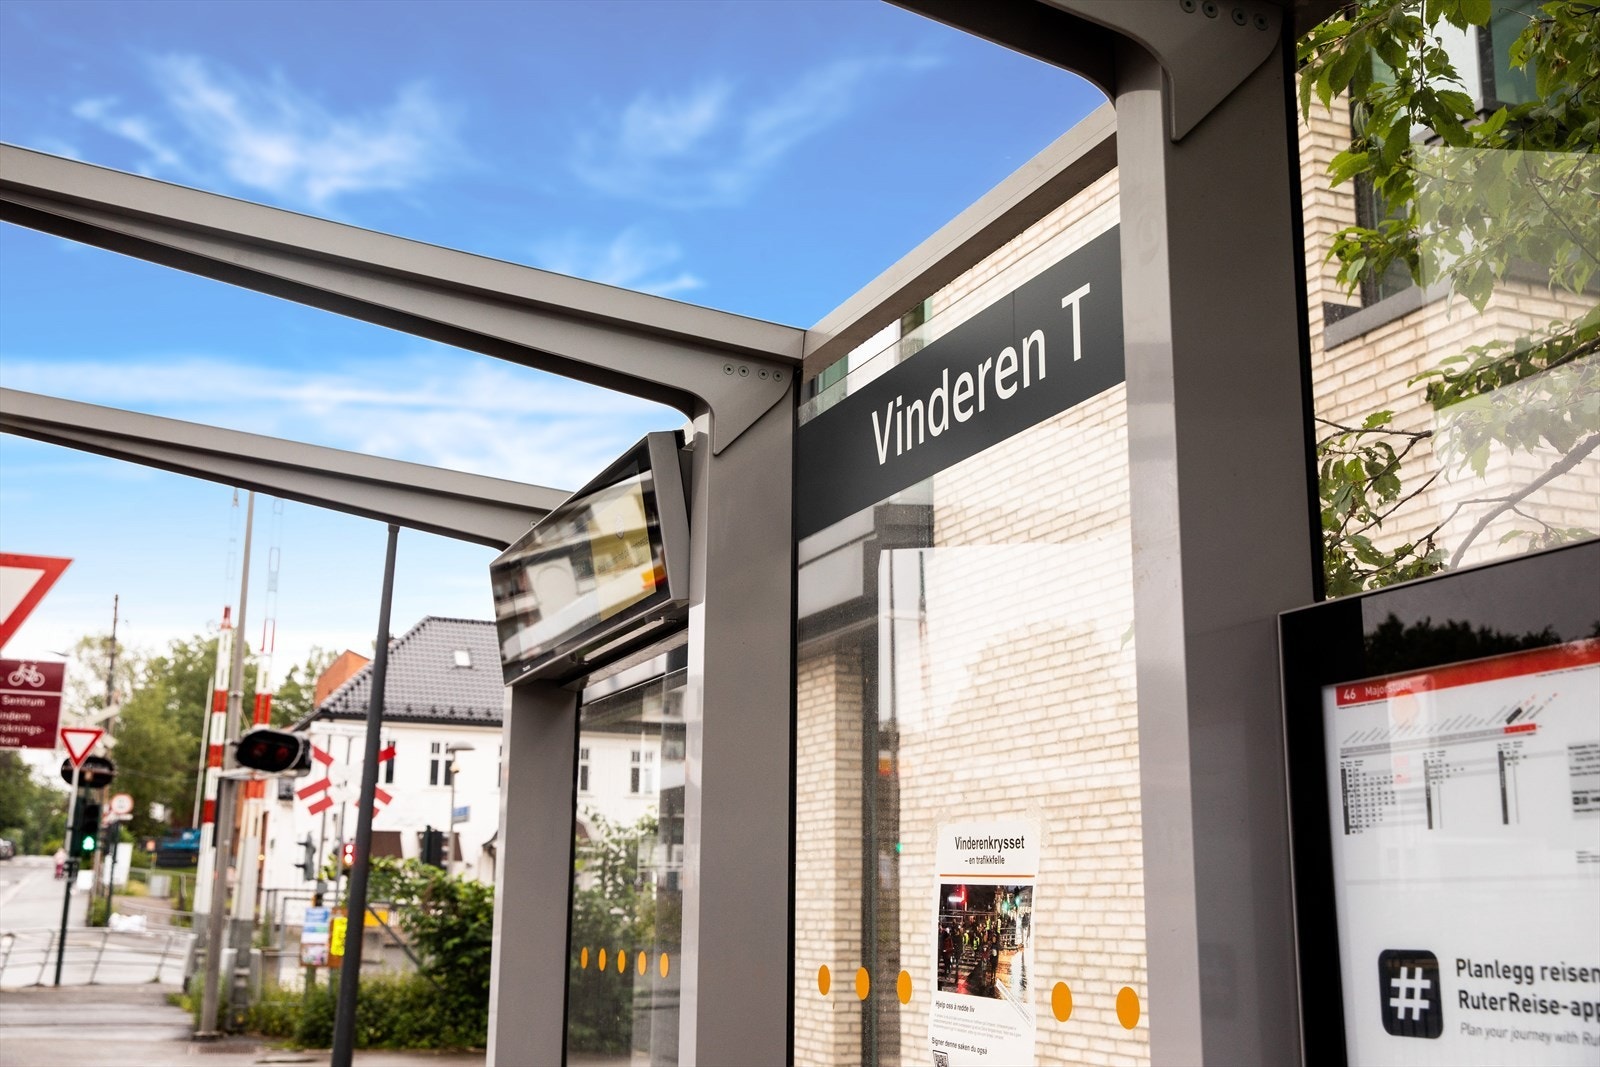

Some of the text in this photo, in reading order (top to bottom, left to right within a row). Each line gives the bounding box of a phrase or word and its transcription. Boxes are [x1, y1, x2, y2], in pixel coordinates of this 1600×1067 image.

[871, 282, 1091, 465] Vinderen T
[1, 694, 46, 707] Sentrum
[1343, 687, 1357, 701] 46
[954, 835, 1025, 853] Vinderenkrysset
[976, 855, 1006, 865] trafikkfelle
[1455, 957, 1600, 986] Planlegg reisen
[1460, 1021, 1483, 1037] Plan
[1484, 1026, 1509, 1041] your
[1510, 1026, 1552, 1046] journey
[1554, 1030, 1580, 1046] with
